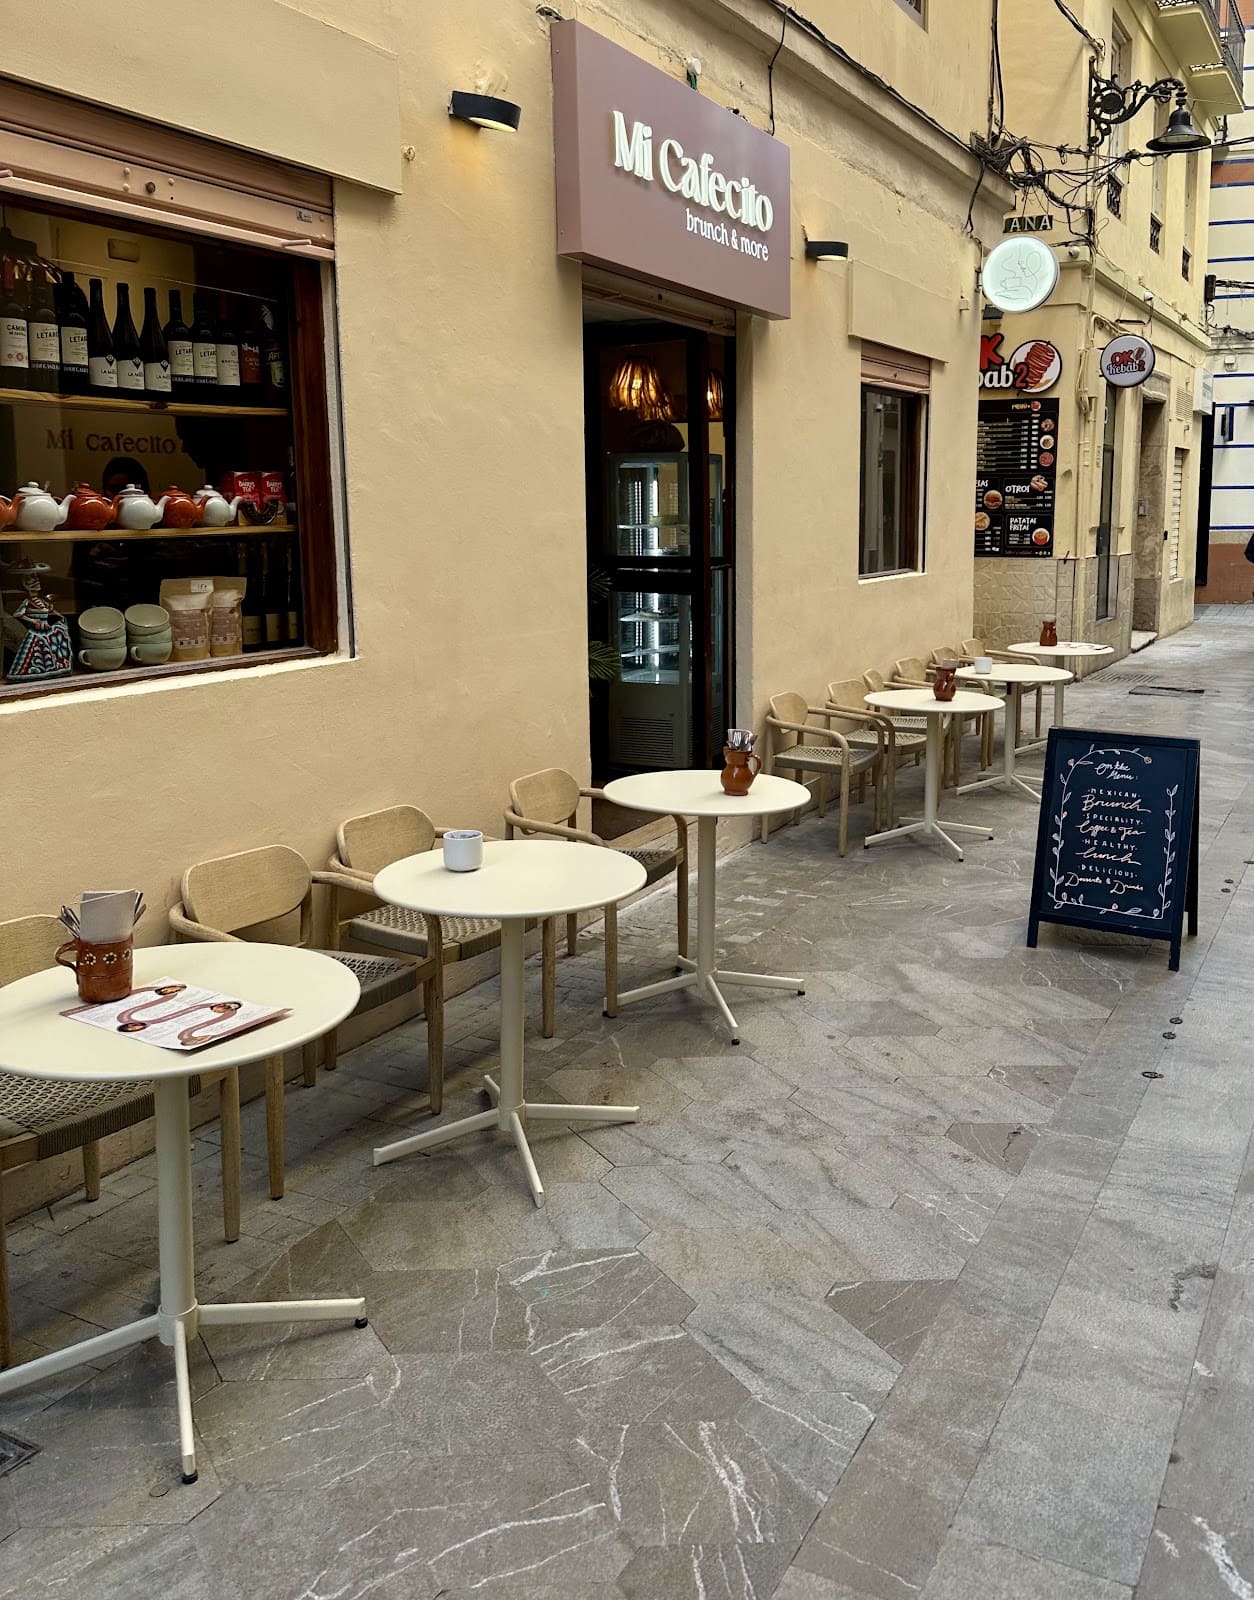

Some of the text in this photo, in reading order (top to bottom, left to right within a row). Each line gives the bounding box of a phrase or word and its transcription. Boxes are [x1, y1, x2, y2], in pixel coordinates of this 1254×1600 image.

[613, 110, 773, 232] Mi Cafecito
[1010, 215, 1052, 232] ANA
[686, 208, 769, 261] brunch & more
[1110, 350, 1134, 366] OK
[1005, 485, 1030, 494] OTROS
[1009, 517, 1037, 525] PATATAS
[1009, 524, 1030, 532] FRITAS
[1113, 761, 1131, 771] the
[1081, 794, 1152, 813] Brunch
[1118, 826, 1147, 841] Tea
